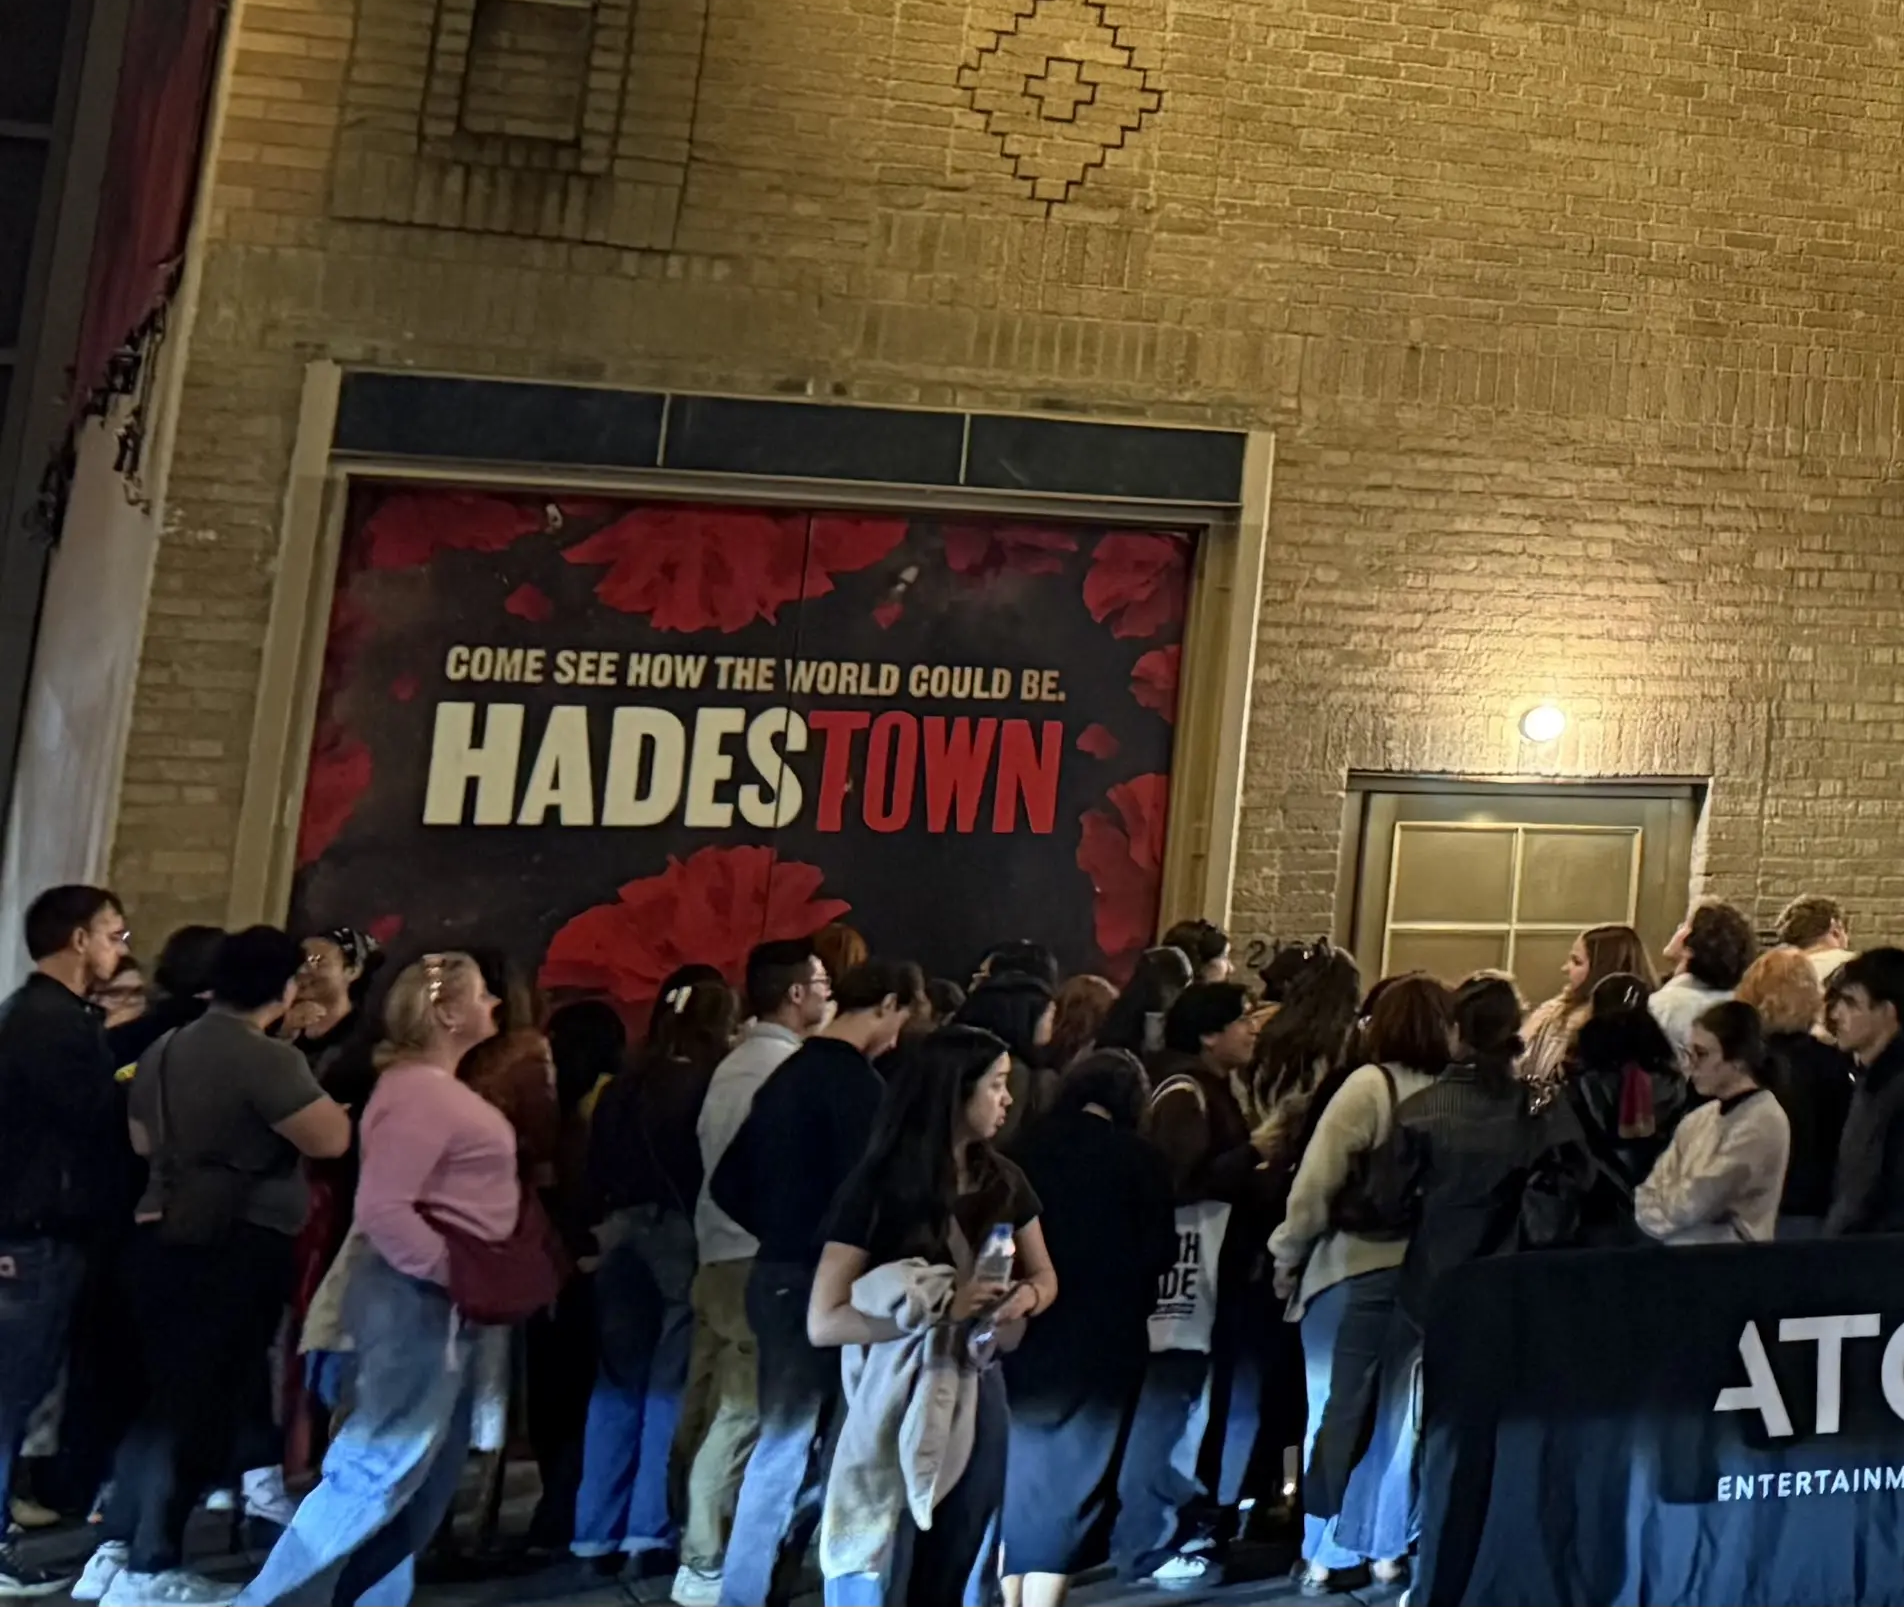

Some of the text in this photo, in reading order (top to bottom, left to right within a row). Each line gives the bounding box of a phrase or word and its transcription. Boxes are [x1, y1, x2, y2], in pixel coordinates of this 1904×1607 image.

[445, 645, 1066, 702] COME SEE HOW THE WORLD COULD BE.
[423, 701, 1063, 834] HADESTOWN
